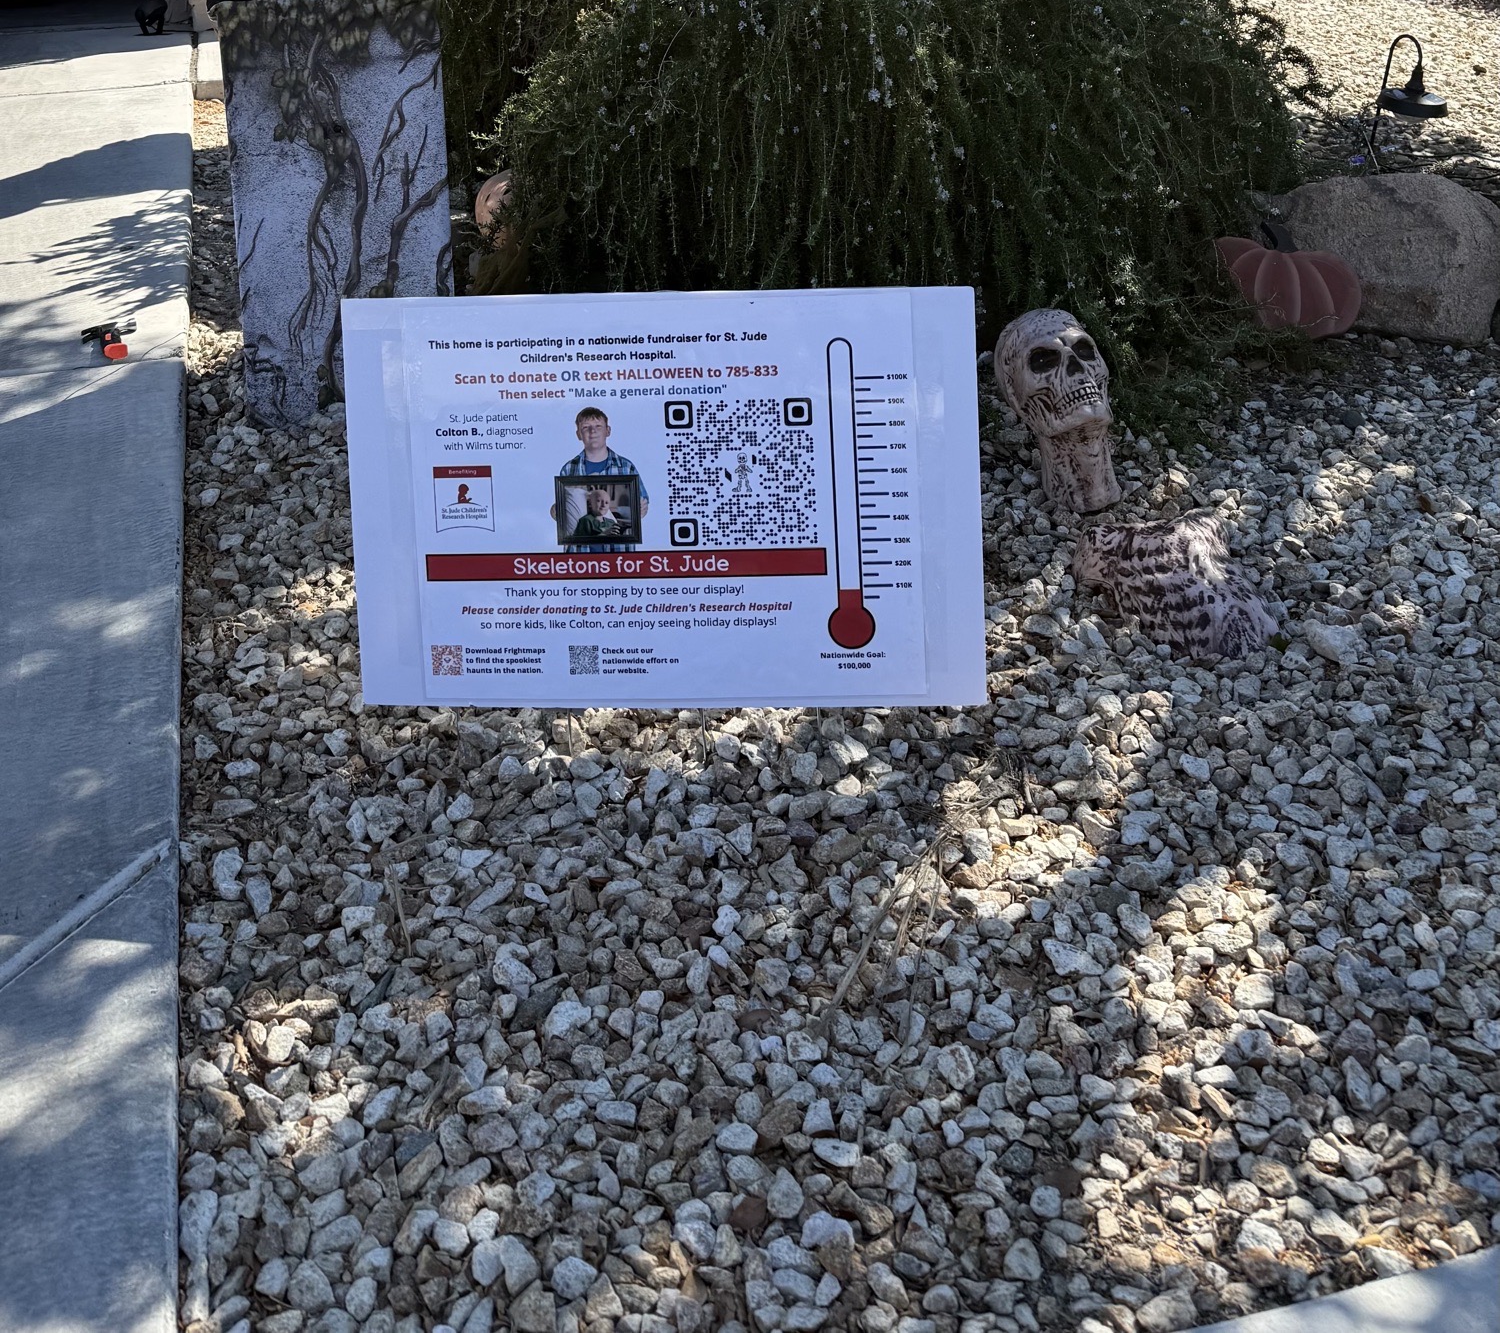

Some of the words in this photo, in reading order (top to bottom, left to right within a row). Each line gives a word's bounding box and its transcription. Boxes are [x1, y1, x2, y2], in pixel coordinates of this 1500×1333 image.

[429, 340, 450, 350] This
[453, 340, 482, 349] home
[485, 339, 494, 348] is
[497, 337, 562, 350] participating
[566, 336, 574, 346] in
[578, 338, 584, 346] a
[588, 335, 644, 345] nationwide
[647, 334, 702, 344] fundraiser
[706, 333, 721, 342] for
[724, 332, 738, 342] St.
[740, 332, 767, 341] Jude
[520, 353, 573, 363] Children's
[576, 352, 626, 362] Research
[630, 350, 676, 362] Hospital.
[454, 373, 486, 385] Scan
[490, 372, 504, 384] to
[508, 370, 557, 383] donate
[561, 370, 580, 382] OR
[584, 370, 612, 381] text
[616, 367, 703, 380] HALLOWEEN
[707, 368, 722, 378] to
[726, 365, 778, 378] 785-833
[499, 389, 528, 400] Then
[531, 388, 565, 398] select
[569, 386, 606, 398] "Make
[610, 388, 617, 396] a
[620, 386, 664, 399] general
[668, 384, 727, 396] donation"
[449, 414, 461, 423] St.
[463, 413, 483, 424] Jude
[486, 413, 518, 424] patient
[435, 427, 468, 437] Colton
[471, 428, 484, 438] B.,
[486, 426, 533, 438] diagnosed
[444, 441, 463, 451] with
[466, 440, 493, 450] Wilms
[496, 441, 526, 450] tumor.
[513, 557, 610, 575] Skeletons
[616, 556, 644, 573] for
[650, 555, 673, 572] St.
[679, 555, 729, 572] Jude
[505, 588, 537, 597] Thank
[540, 589, 559, 599] you
[563, 587, 578, 596] for
[581, 586, 627, 598] stopping
[631, 586, 643, 597] by
[646, 587, 657, 595] to
[682, 586, 700, 594] our
[704, 584, 744, 596] display!
[462, 606, 494, 615] Please
[497, 605, 540, 614] consider
[543, 604, 587, 616] donating
[591, 605, 601, 613] to
[604, 605, 616, 613] St.
[620, 604, 643, 615] Jude
[645, 603, 696, 613] Children's
[699, 603, 745, 612] Research
[749, 601, 792, 612] Hospital
[481, 621, 492, 630] so
[495, 621, 521, 629] more
[525, 620, 547, 630] kids,
[550, 620, 566, 628] like
[569, 619, 605, 629] Colton,
[607, 620, 625, 628] can
[628, 618, 655, 630] enjoy
[658, 618, 691, 629] seeing
[693, 617, 730, 628] holiday
[733, 617, 777, 627] displays!
[504, 647, 545, 655] Frightmaps
[506, 657, 541, 665] spookiest
[617, 666, 649, 674] website.
